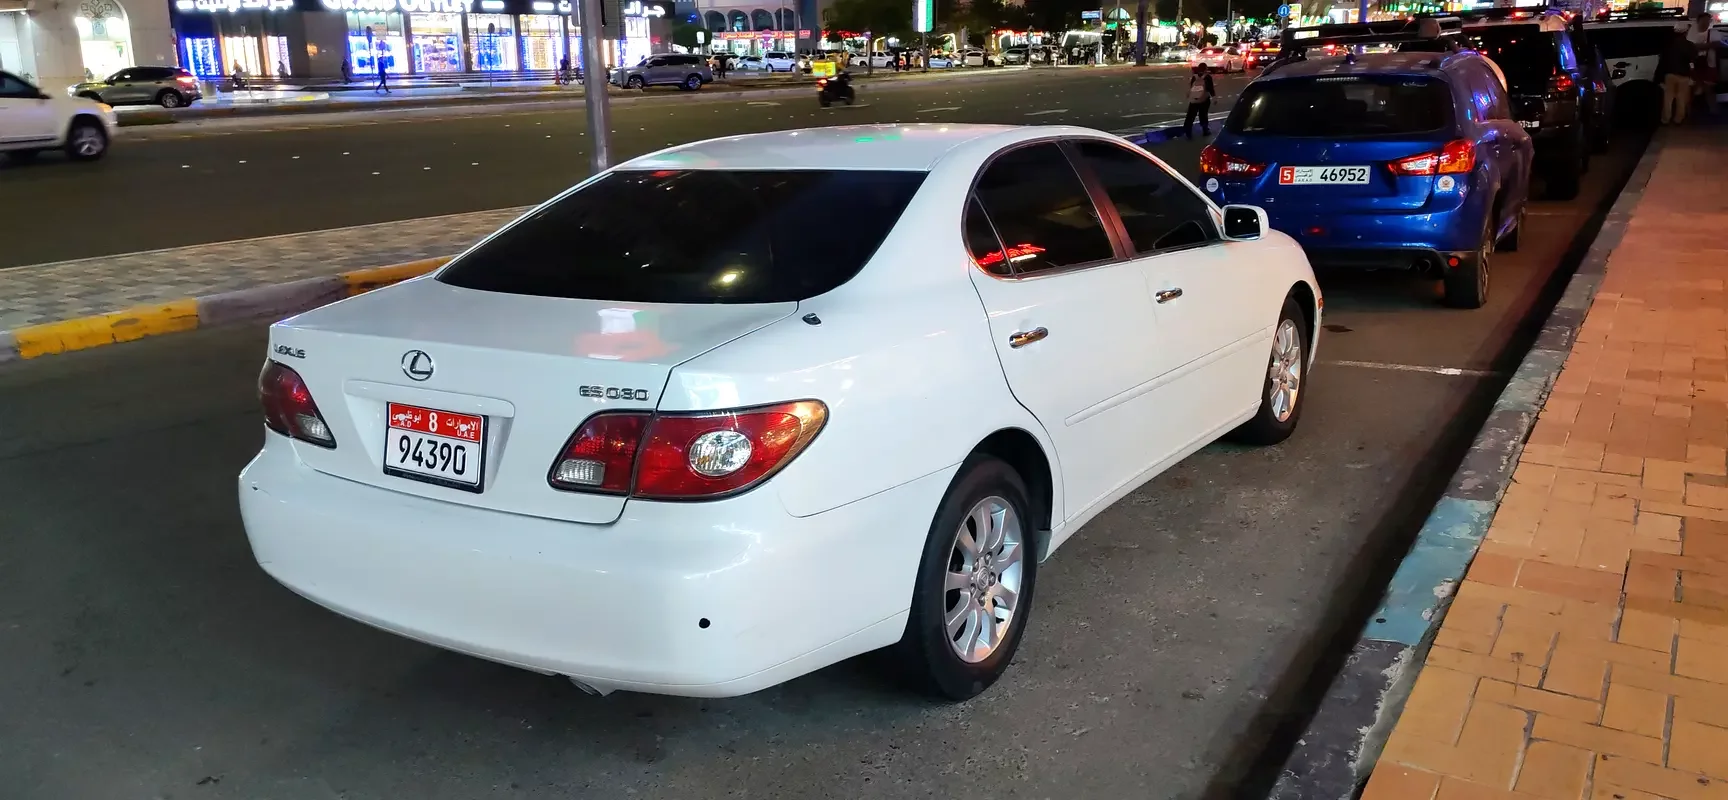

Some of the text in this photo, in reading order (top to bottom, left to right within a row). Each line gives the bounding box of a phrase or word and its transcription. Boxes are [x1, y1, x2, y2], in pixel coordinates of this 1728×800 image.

[1283, 169, 1292, 181] 5
[1320, 168, 1366, 182] 46952
[428, 412, 438, 432] 8
[399, 435, 467, 476] 94390
